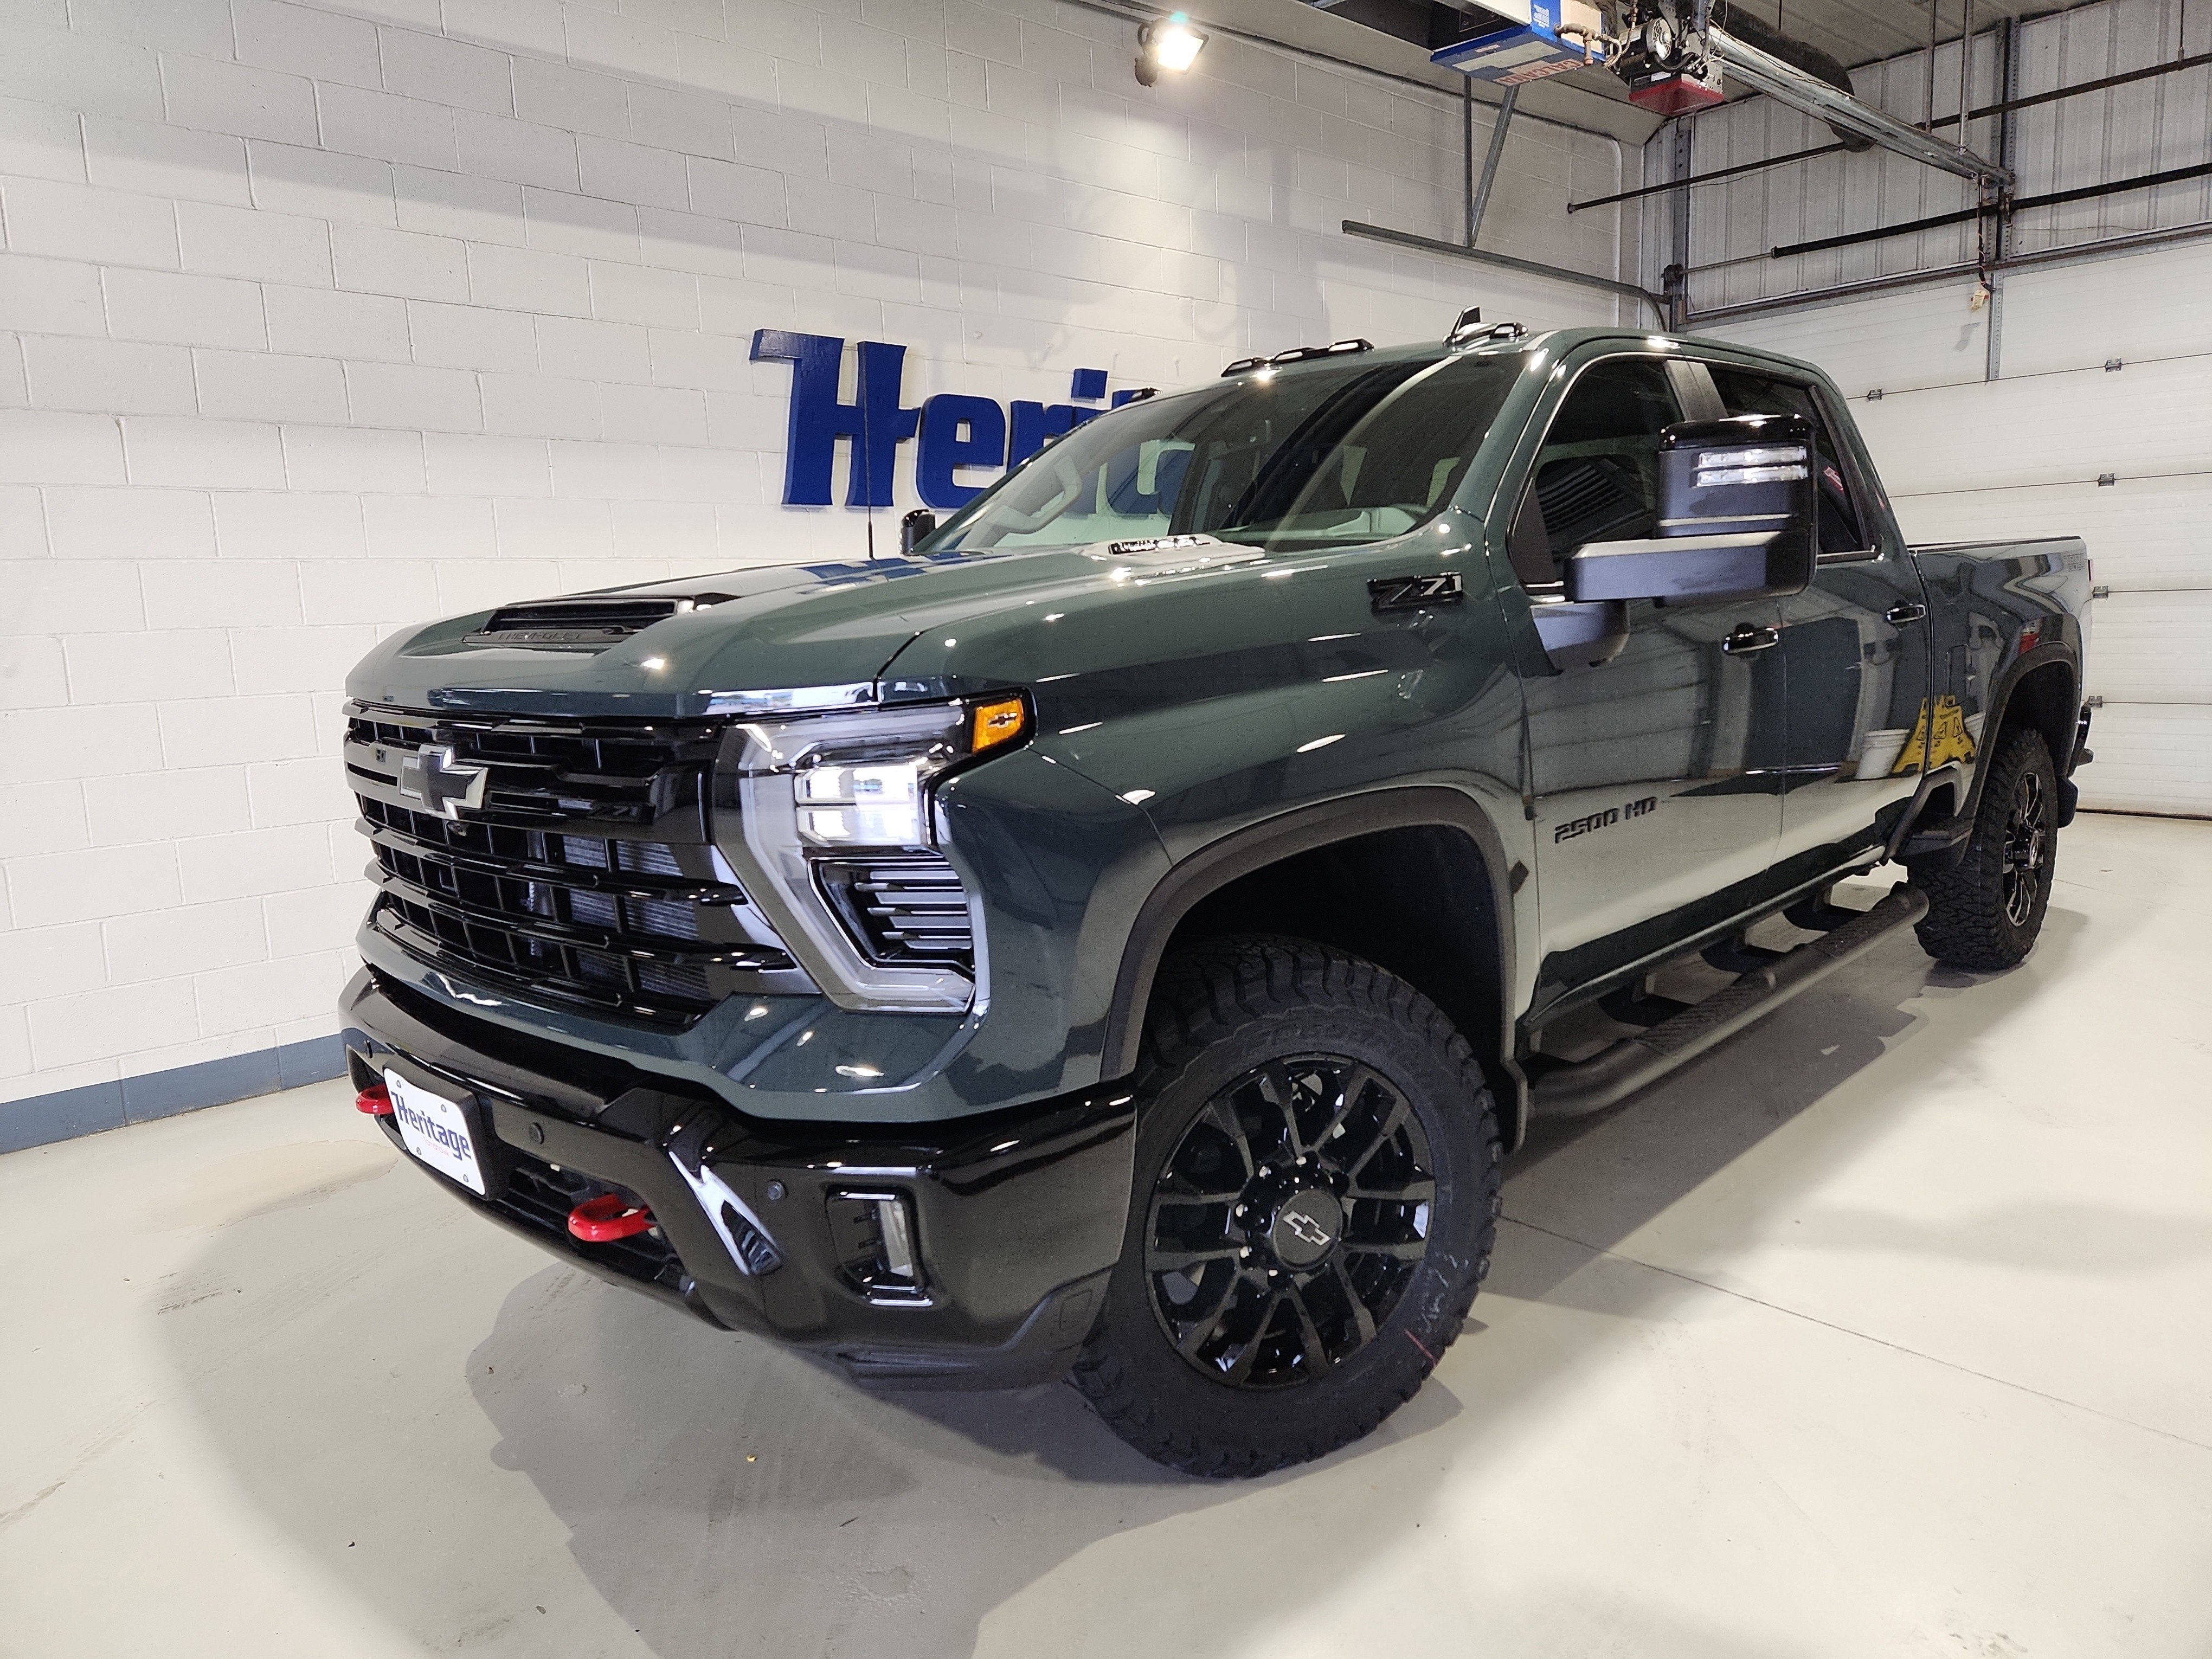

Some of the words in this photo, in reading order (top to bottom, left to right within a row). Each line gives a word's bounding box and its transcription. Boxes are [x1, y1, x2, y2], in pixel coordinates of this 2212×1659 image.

[2063, 553, 2087, 564] TRAIL
[2067, 563, 2086, 572] BOSS
[1367, 571, 1464, 612] Z71
[498, 631, 588, 641] CHEVROLET
[1555, 807, 1620, 844] 2500
[1624, 796, 1658, 820] HD
[390, 1090, 472, 1161] Heritage
